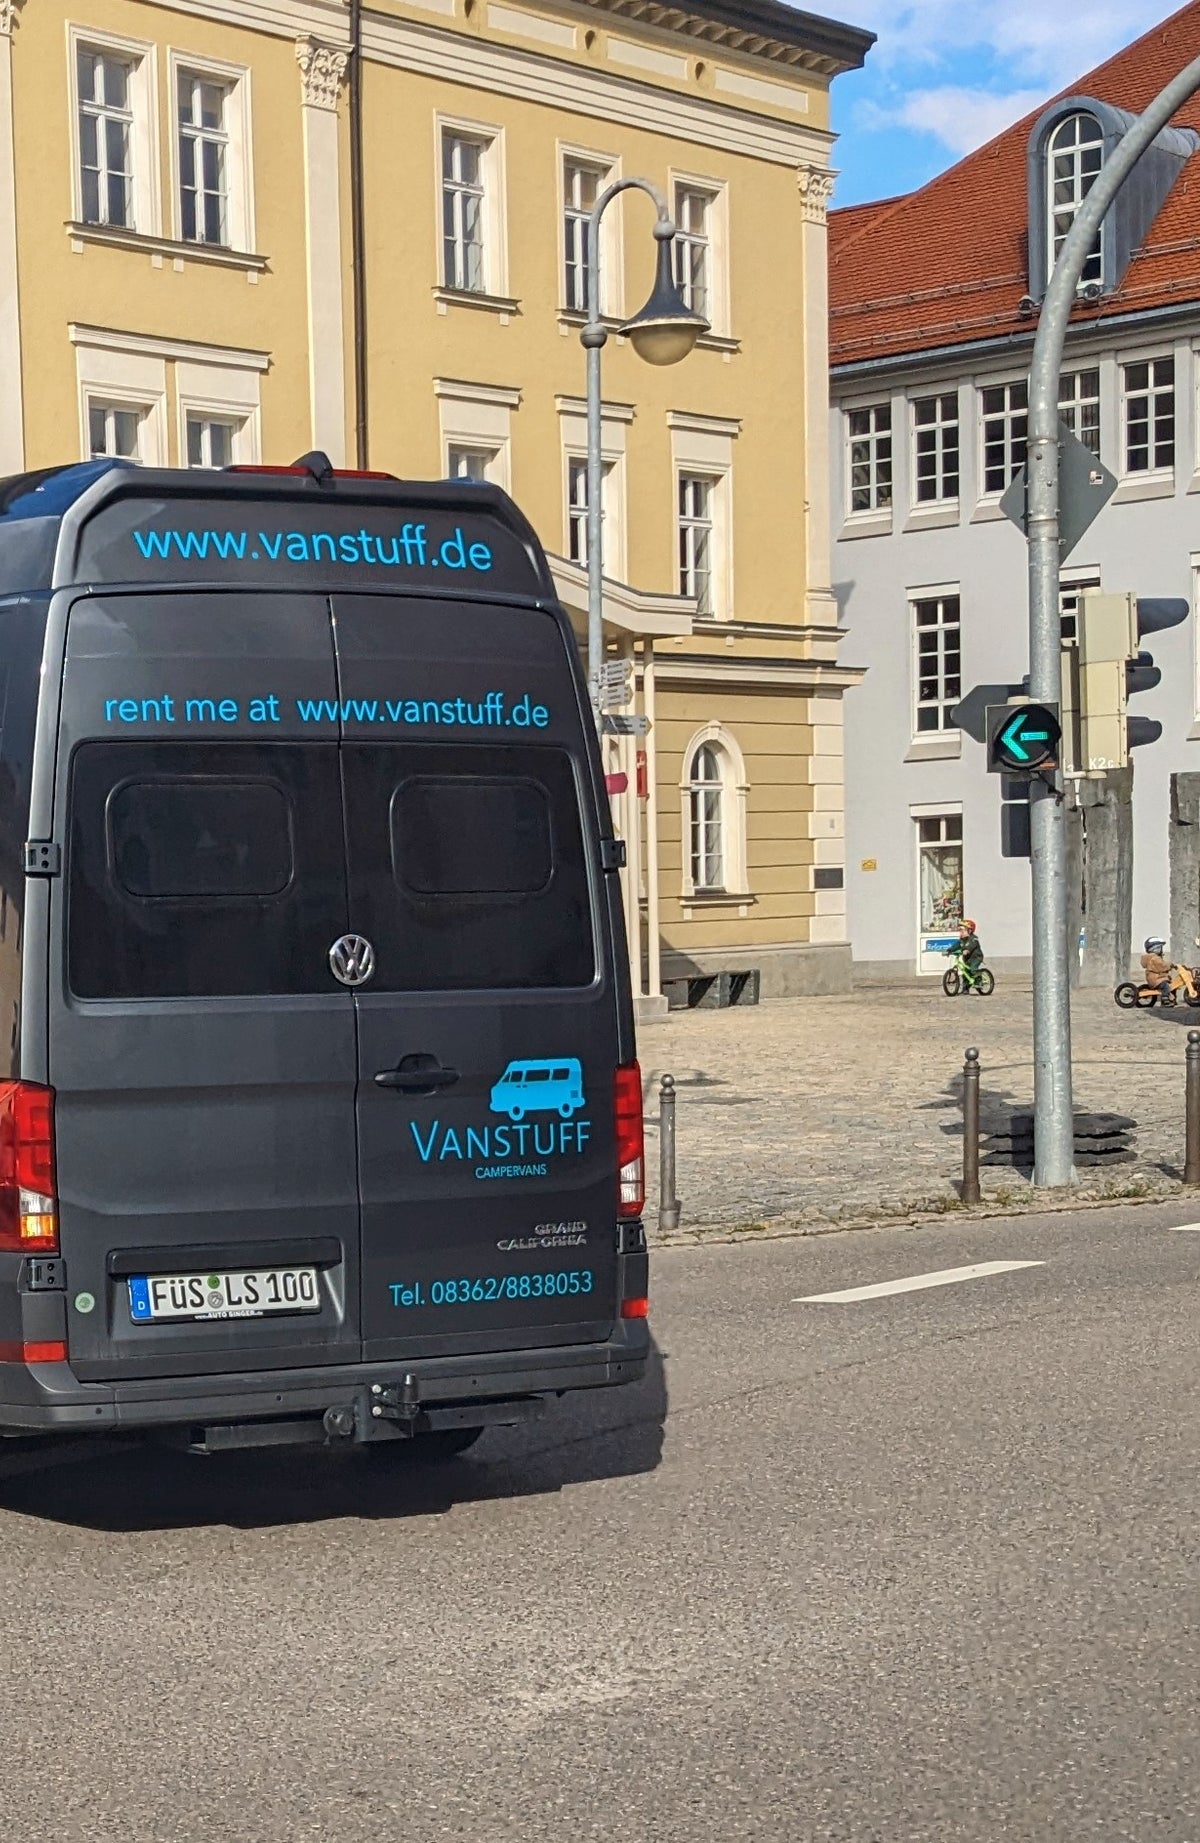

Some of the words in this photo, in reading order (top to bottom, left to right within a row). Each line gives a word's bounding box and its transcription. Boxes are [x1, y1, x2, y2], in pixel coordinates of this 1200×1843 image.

[132, 523, 493, 572] www.vanstuff.de
[104, 693, 175, 723] rent
[184, 698, 239, 723] me
[248, 694, 281, 722] at
[297, 692, 550, 728] www.vanstuff.de
[475, 1163, 548, 1179] CAMPERVANS
[138, 1301, 146, 1311] D
[225, 1275, 260, 1306] LS
[265, 1271, 315, 1303] 100
[388, 1283, 425, 1306] Tel.
[431, 1271, 592, 1304] 08362/8838053
